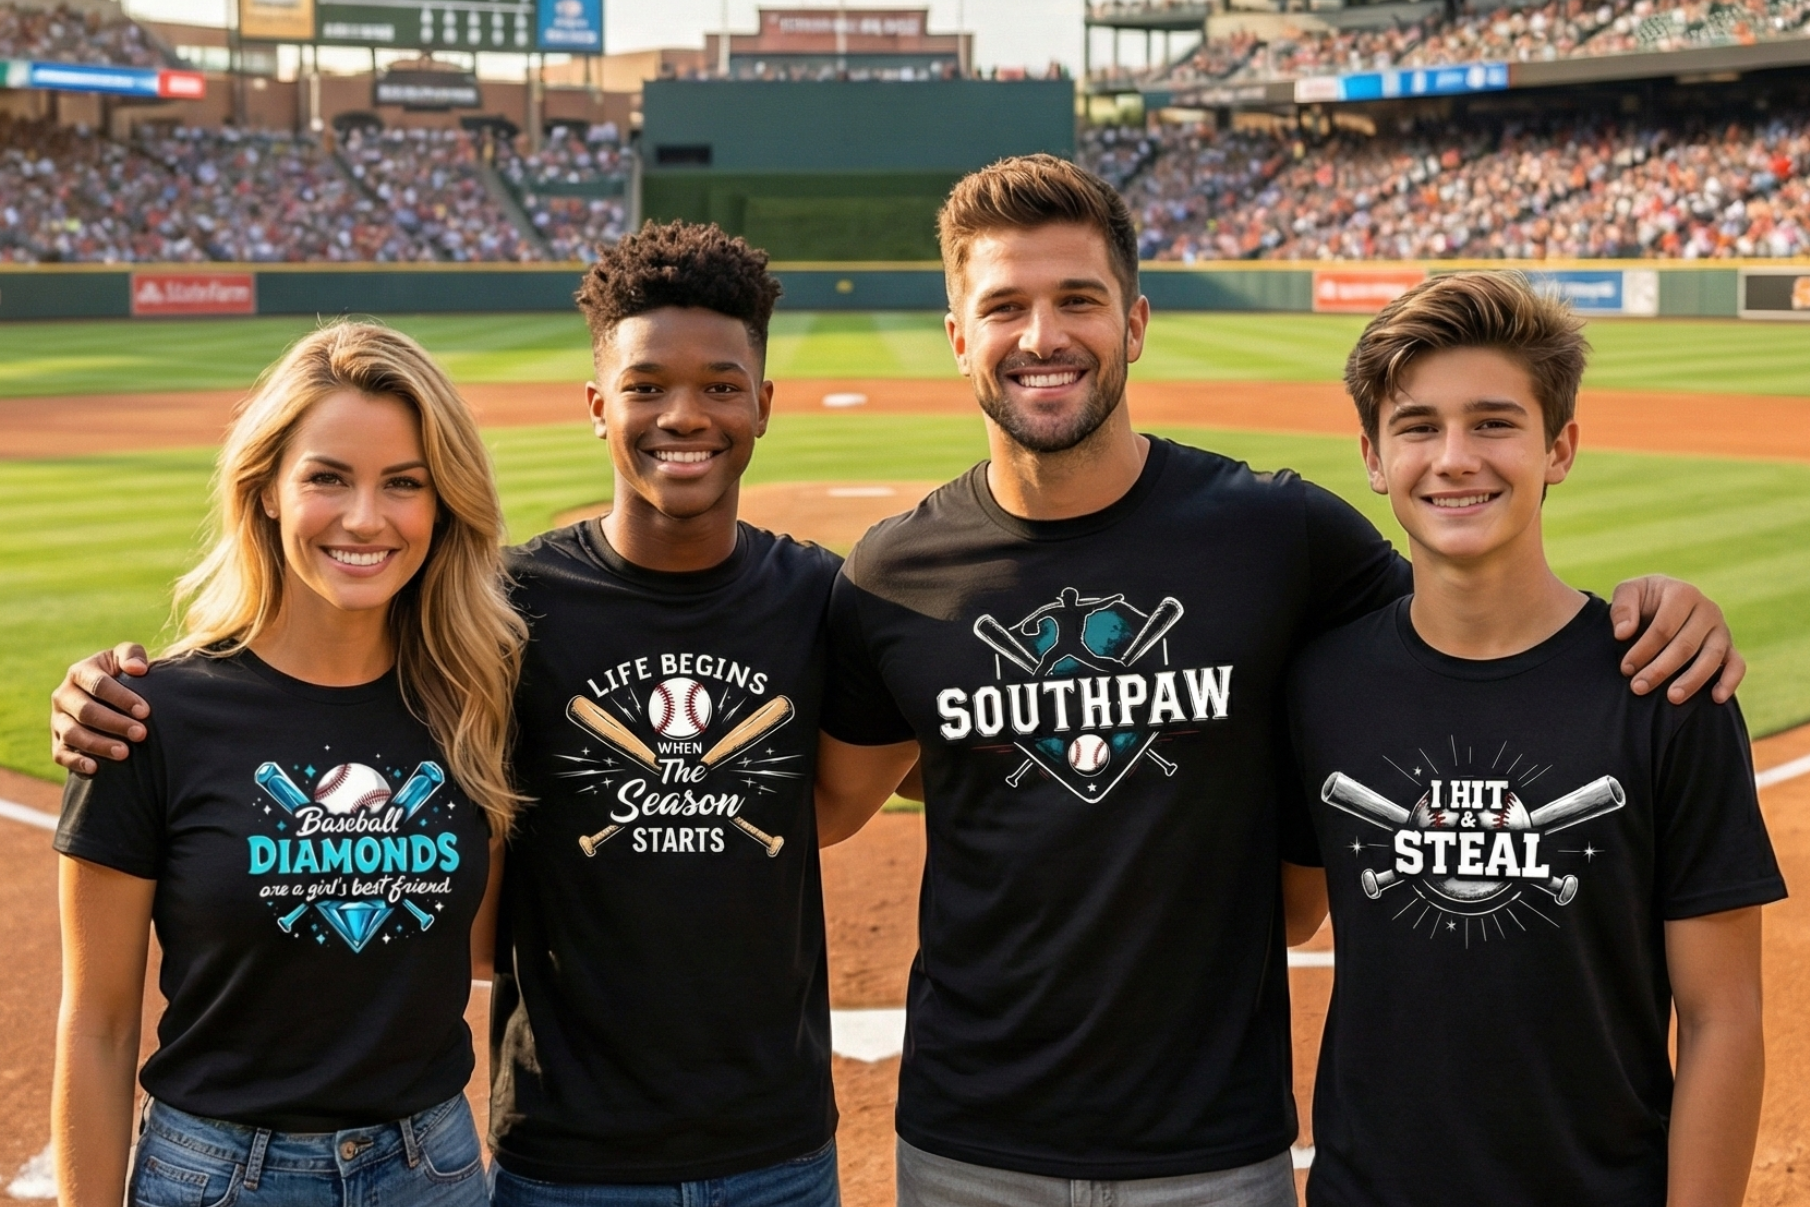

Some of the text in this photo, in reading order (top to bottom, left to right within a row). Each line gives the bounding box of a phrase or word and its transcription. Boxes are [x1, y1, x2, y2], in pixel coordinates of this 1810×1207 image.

[587, 653, 768, 698] LIFE BEGINS
[936, 665, 1233, 740] SOUTHPAW
[657, 742, 703, 754] WHEN
[658, 758, 708, 784] The
[610, 778, 745, 823] Season
[1431, 780, 1508, 809] I HIT
[295, 806, 403, 836] Baseball
[1460, 811, 1476, 828] &
[248, 832, 460, 875] DIAMONDS
[632, 827, 725, 852] STARTS
[1394, 830, 1549, 878] STEAL
[292, 884, 304, 896] a
[306, 878, 347, 901] girl's
[351, 875, 393, 896] best
[388, 874, 452, 903] friend
